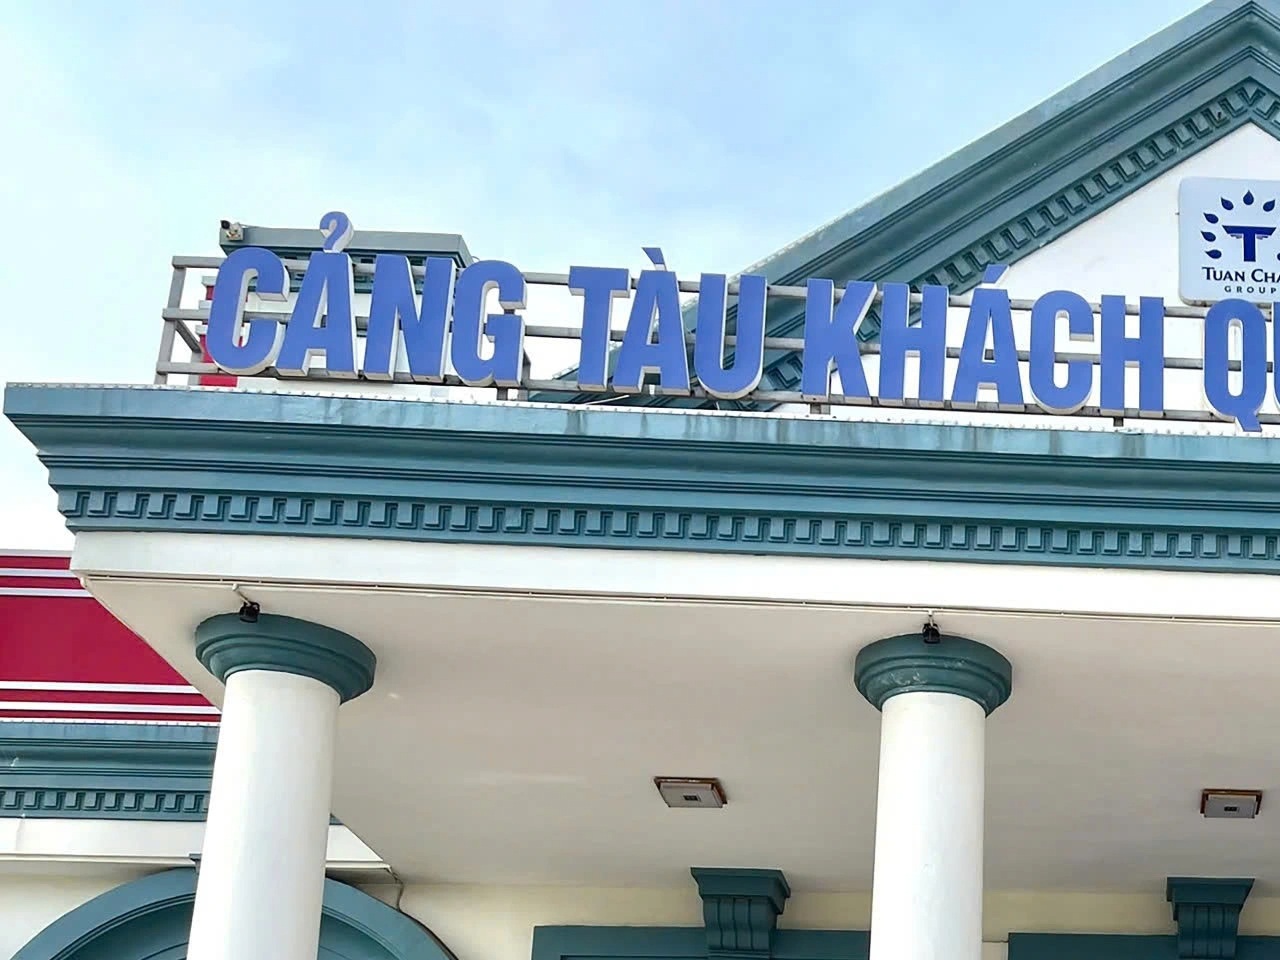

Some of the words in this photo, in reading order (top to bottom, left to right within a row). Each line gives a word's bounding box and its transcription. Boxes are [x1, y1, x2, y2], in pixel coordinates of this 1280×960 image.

[207, 211, 527, 387] CẢNG
[568, 247, 767, 399] TÀU
[801, 264, 1165, 415] KHÁCH
[1224, 285, 1277, 294] GROUP
